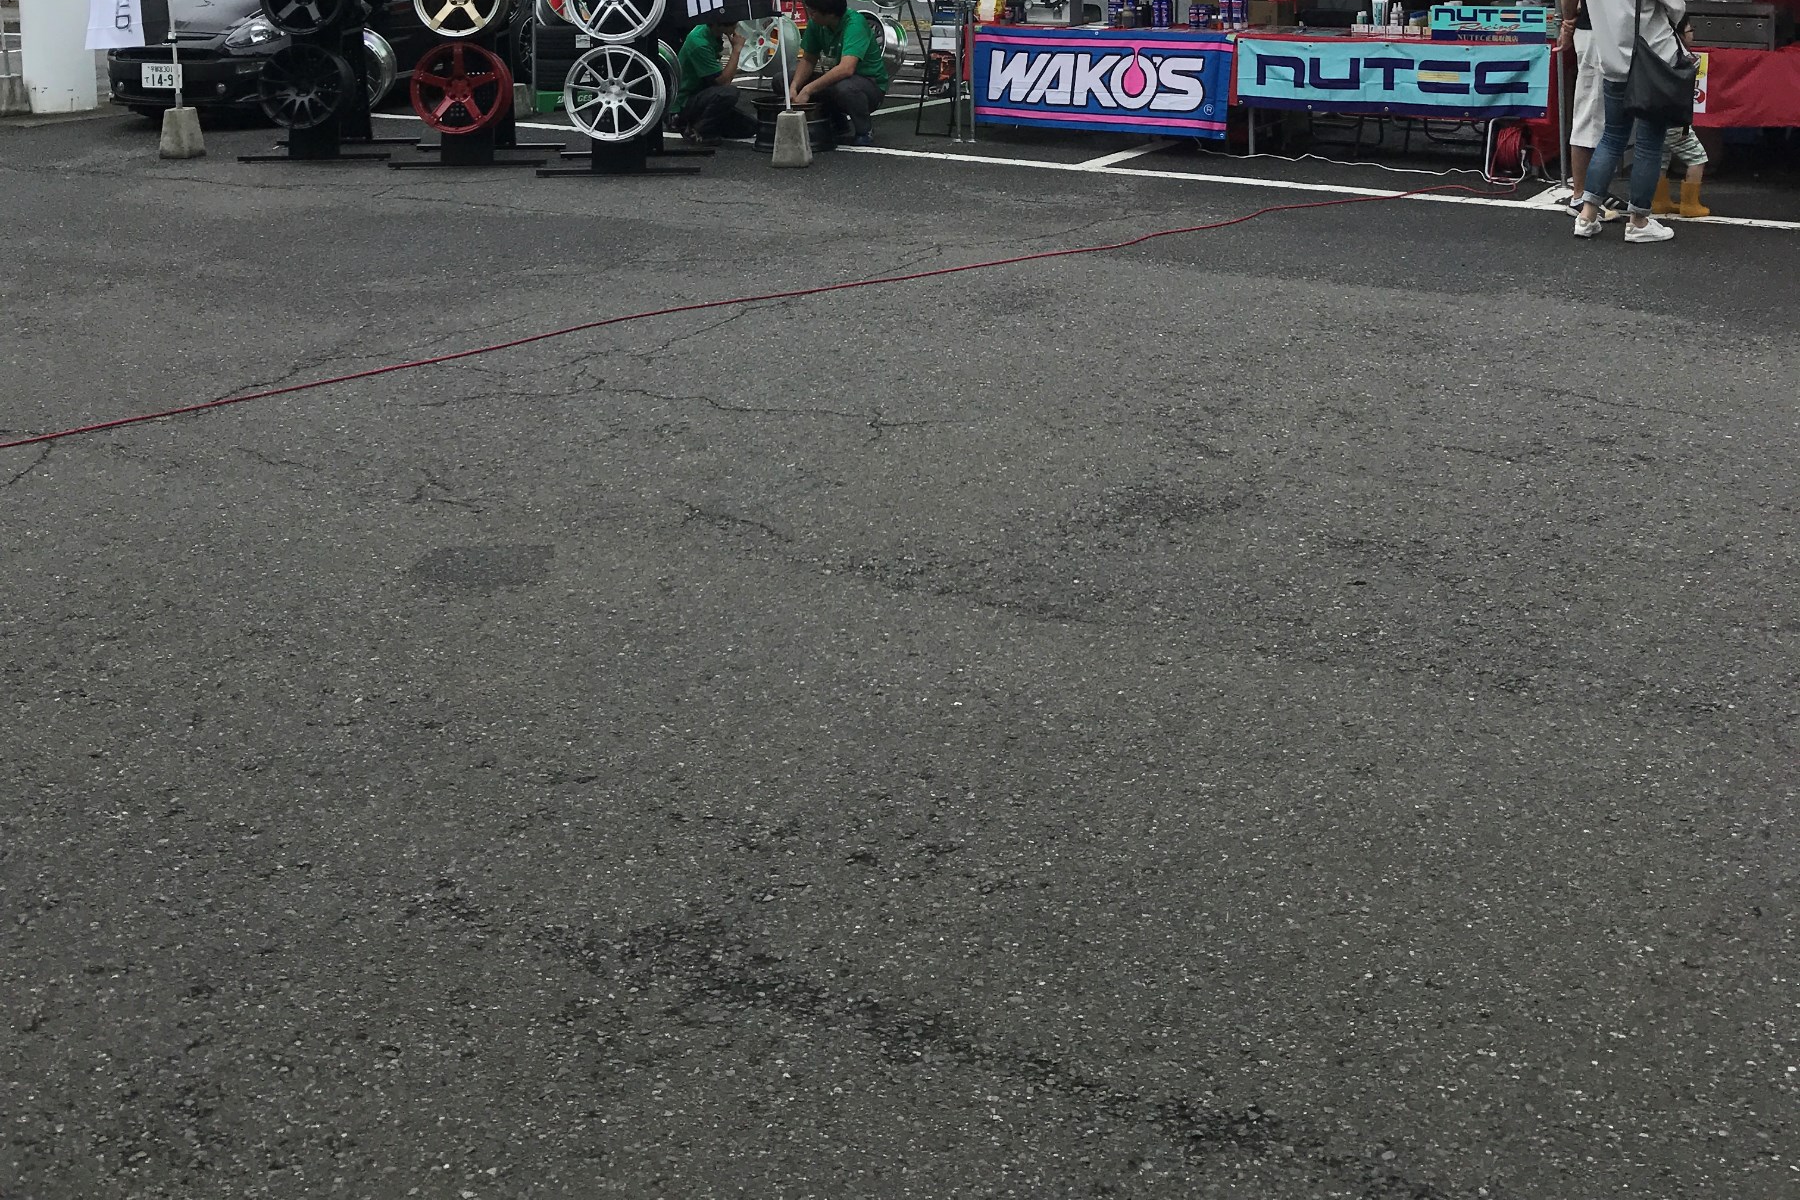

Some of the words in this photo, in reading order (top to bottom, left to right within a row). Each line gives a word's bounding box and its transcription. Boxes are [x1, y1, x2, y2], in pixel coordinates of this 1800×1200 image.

[1434, 8, 1544, 23] NUTEC
[151, 73, 178, 87] 14-9
[987, 46, 1205, 112] WAKO'S
[1256, 54, 1530, 96] NUTEC
